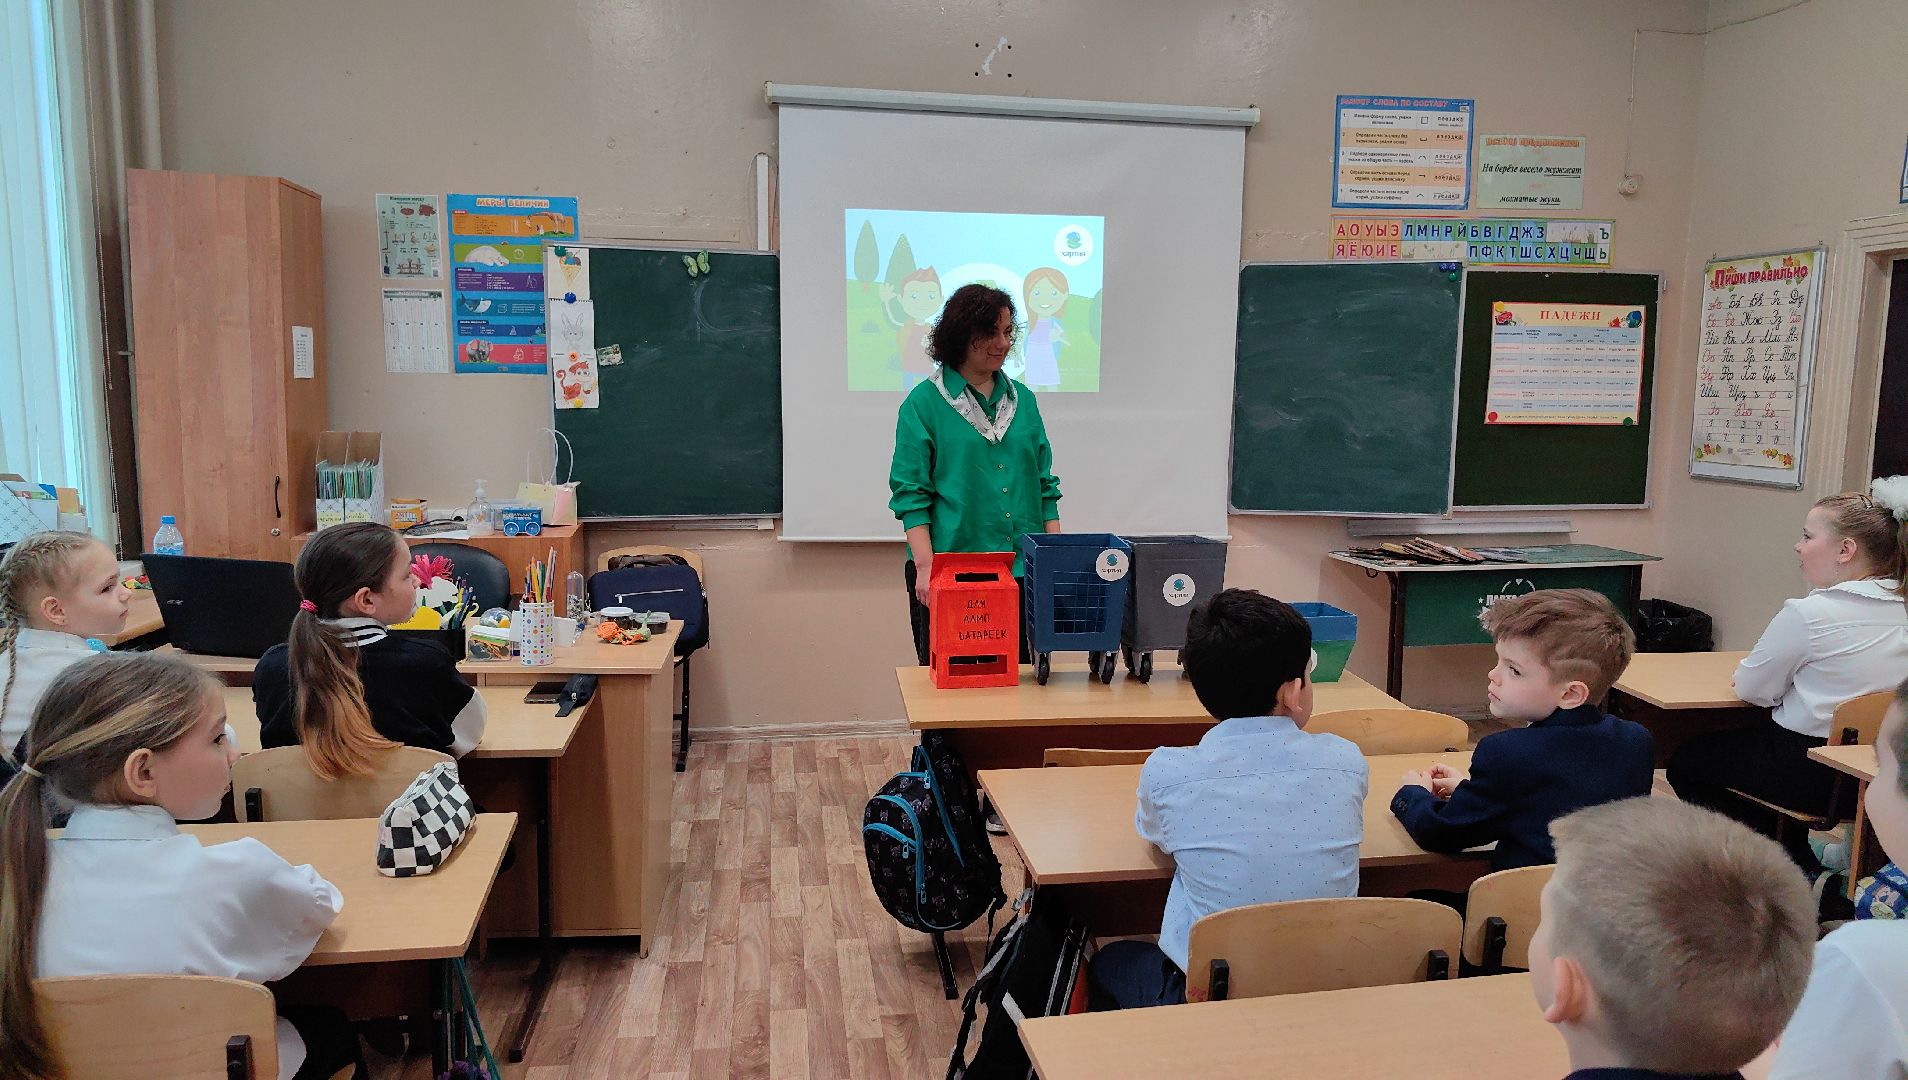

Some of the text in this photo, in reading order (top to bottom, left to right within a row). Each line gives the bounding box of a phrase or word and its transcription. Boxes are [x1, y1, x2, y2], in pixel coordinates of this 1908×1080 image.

[1373, 98, 1398, 106] СЛОВА
[1414, 100, 1448, 108] СОСТАВУ
[1482, 164, 1492, 172] На
[1494, 164, 1518, 174] берёзе
[1544, 166, 1582, 176] жужжат
[476, 198, 550, 208] МЕРЫ ВЕЛИЧИН
[1540, 310, 1600, 321] ПАДЕЖИ
[967, 600, 986, 609] ДЛЯ
[964, 614, 990, 624] ЛАМП
